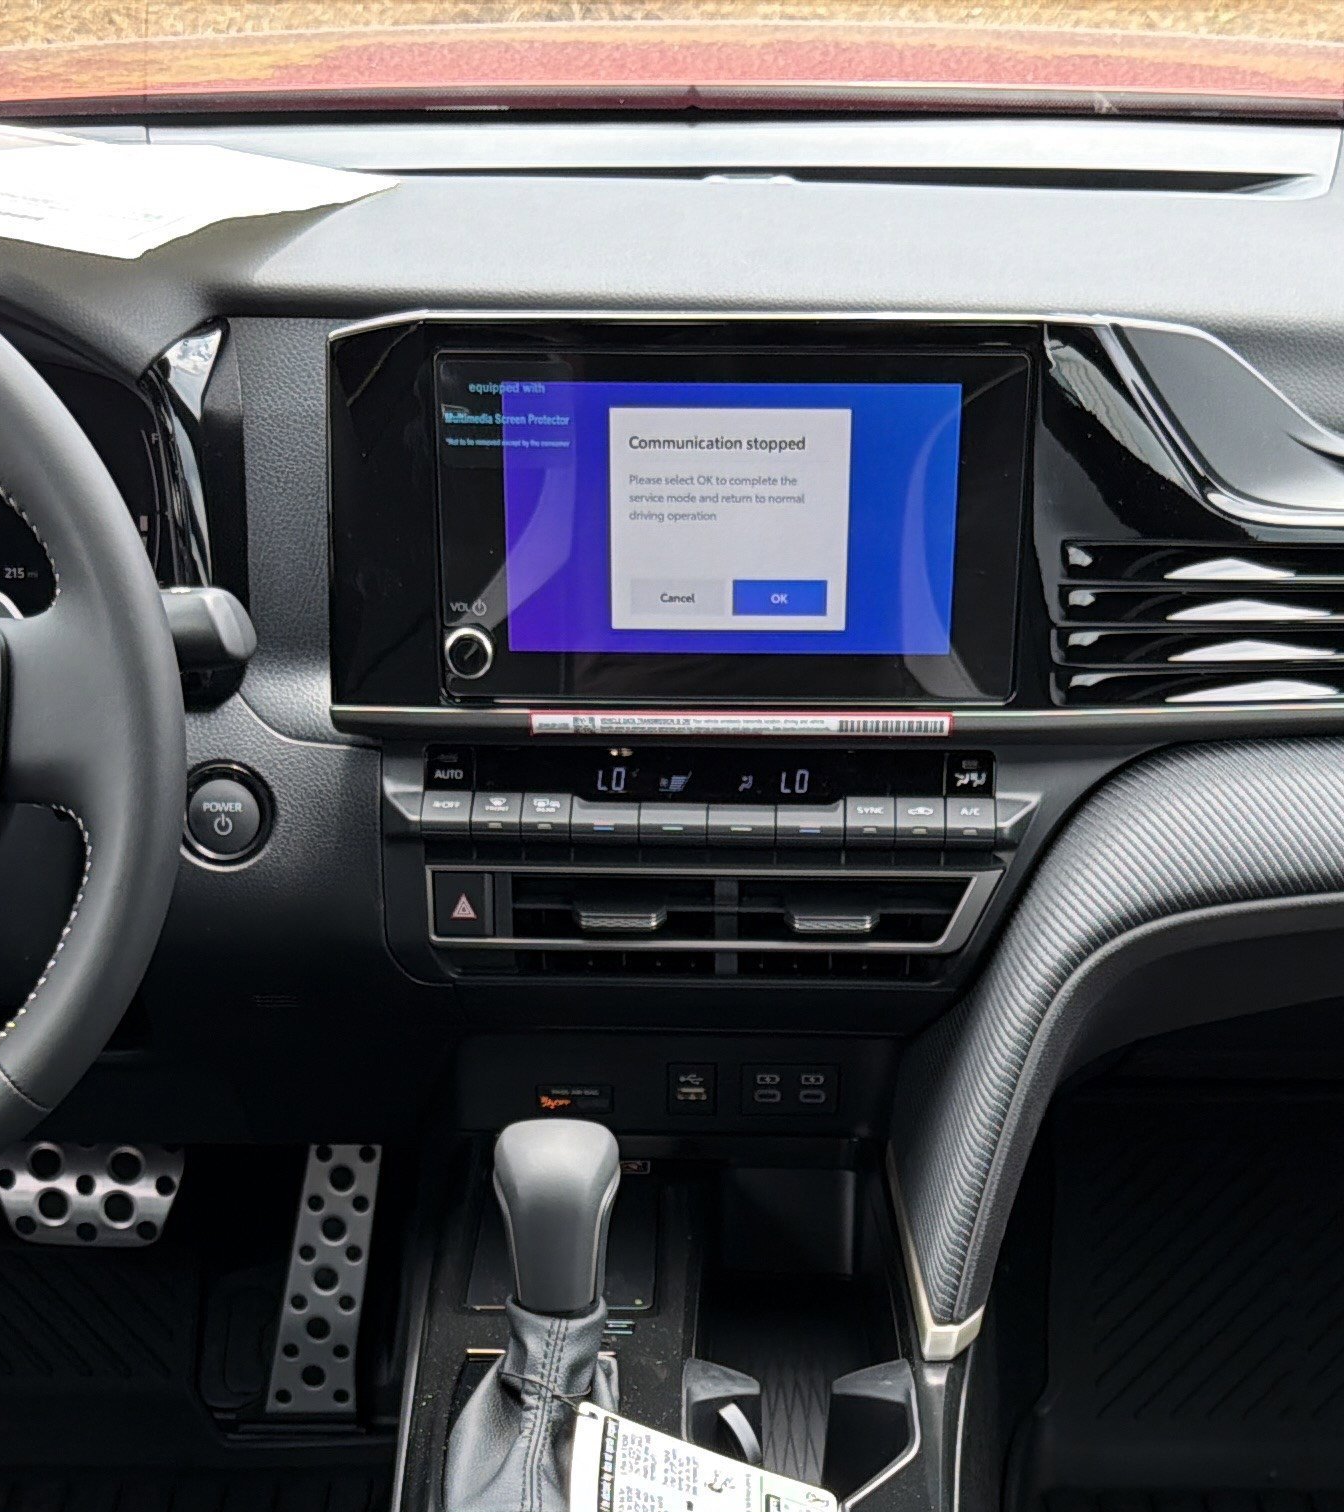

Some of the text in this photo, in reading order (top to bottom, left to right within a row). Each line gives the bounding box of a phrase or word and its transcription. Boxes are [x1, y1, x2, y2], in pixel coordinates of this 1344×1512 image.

[468, 382, 546, 395] equipped with
[494, 413, 526, 425] Screen
[527, 413, 570, 425] Protector
[629, 435, 806, 453] Communication stopped
[629, 474, 798, 488] Please select OK to complete the
[629, 493, 805, 504] service mode and return to normal
[629, 510, 717, 523] driving operation
[4, 567, 25, 579] 215
[660, 593, 695, 604] Cancel
[771, 594, 788, 604] OK
[449, 602, 471, 613] VOL
[434, 769, 463, 780] AUTO
[597, 767, 626, 791] LO
[780, 769, 809, 793] LO
[203, 802, 243, 812] POWER
[856, 806, 884, 815] SYNC
[960, 807, 980, 816] A/C
